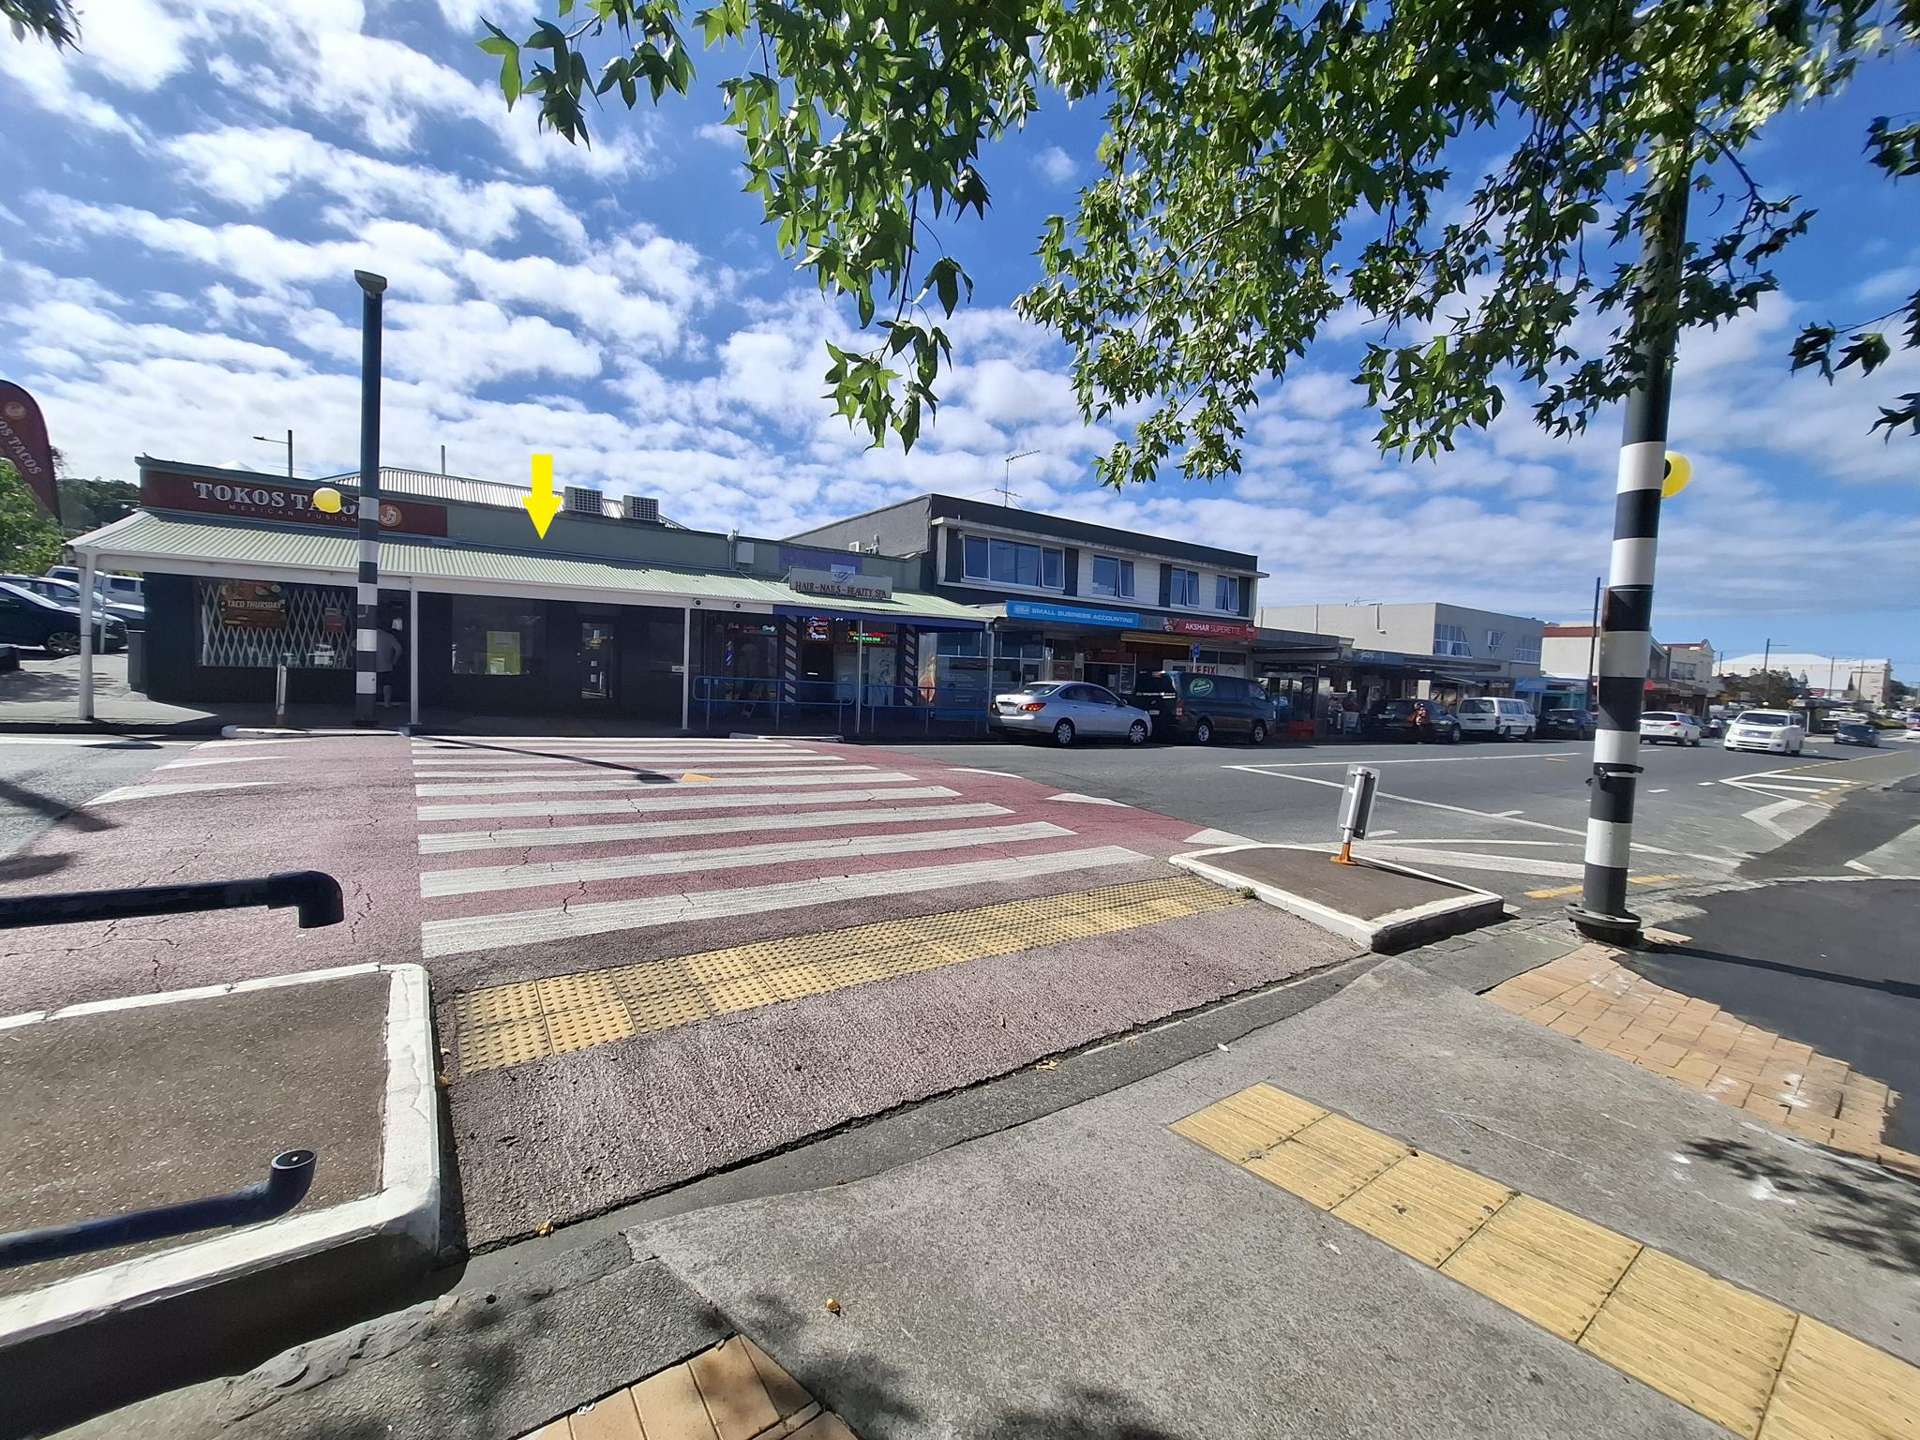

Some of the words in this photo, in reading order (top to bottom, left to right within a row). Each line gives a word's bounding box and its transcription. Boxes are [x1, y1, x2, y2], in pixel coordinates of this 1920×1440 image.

[8, 436, 42, 474] TACOS
[193, 481, 285, 508] TOKOS
[228, 504, 294, 517] MEXICAN
[1184, 623, 1210, 632] AKSHAR
